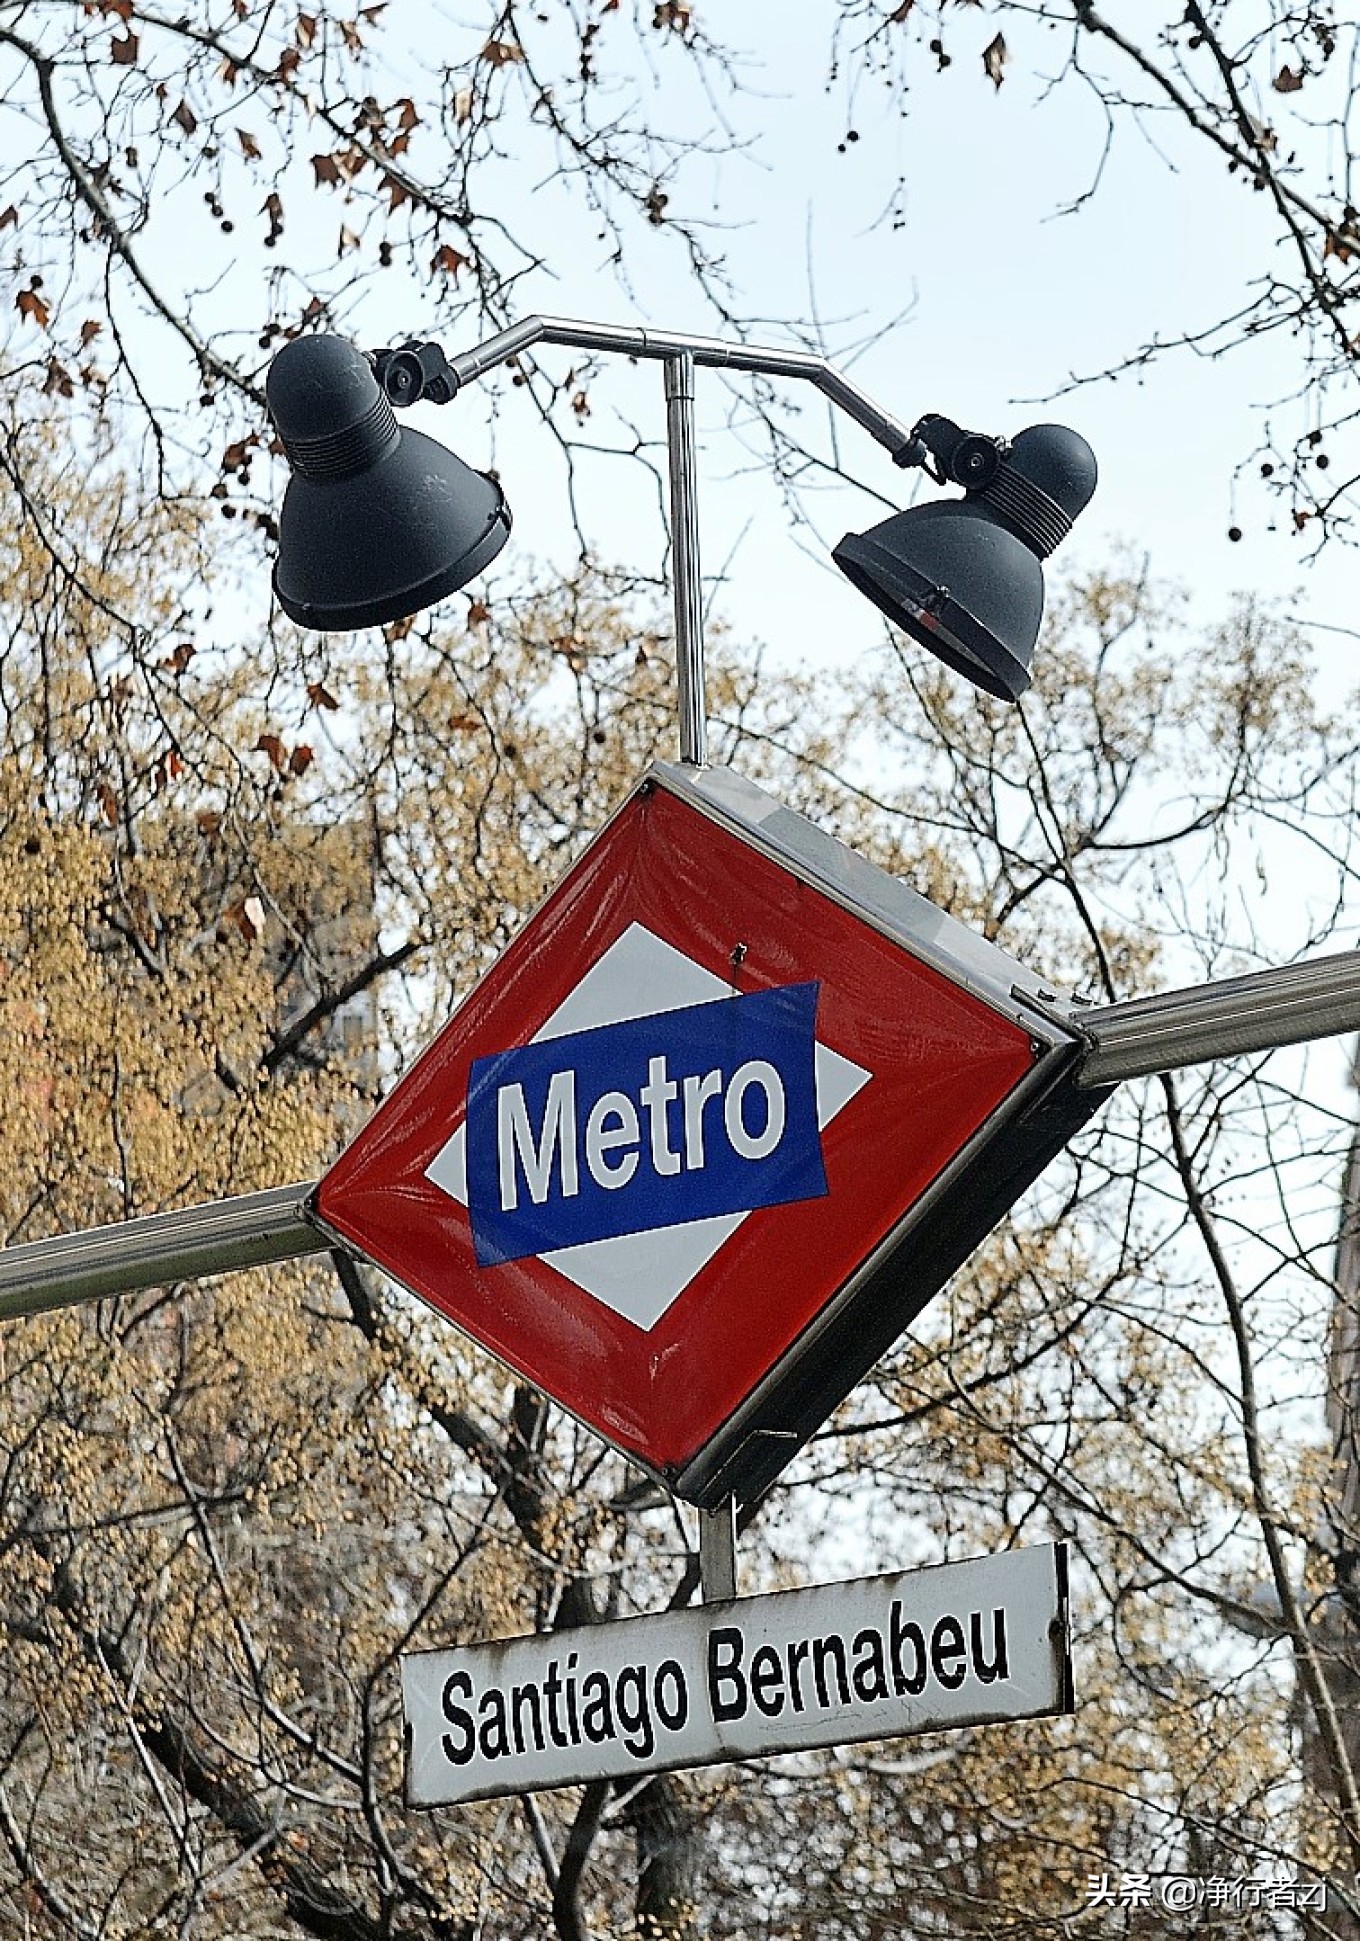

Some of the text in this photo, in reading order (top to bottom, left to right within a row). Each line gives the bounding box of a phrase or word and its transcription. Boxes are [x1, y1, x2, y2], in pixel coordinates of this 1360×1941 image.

[498, 1055, 786, 1212] Metro
[441, 1601, 1009, 1765] Santiago Bernabeu
